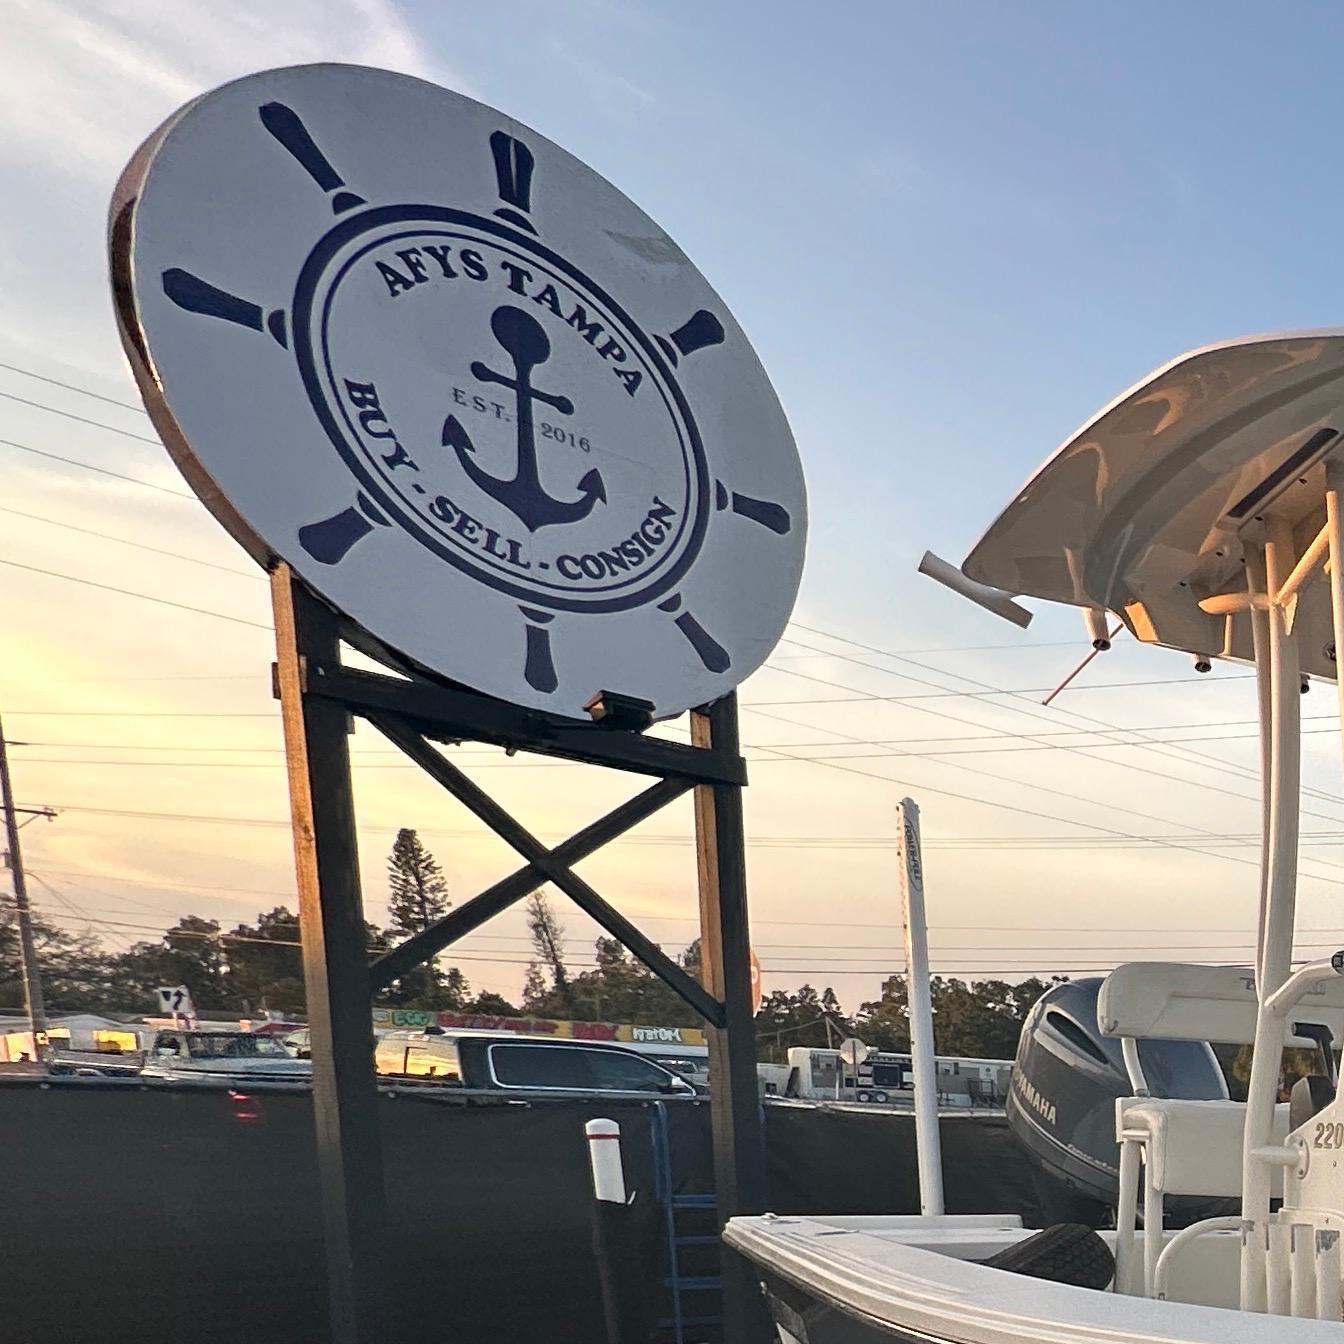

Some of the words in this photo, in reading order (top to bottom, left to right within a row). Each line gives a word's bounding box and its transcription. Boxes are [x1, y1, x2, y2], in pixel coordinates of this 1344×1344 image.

[375, 245, 489, 298] AFYS
[500, 261, 643, 398] TAMPA
[344, 378, 420, 472] BUY
[429, 495, 532, 570] SELL
[556, 496, 678, 581] CONSIGN
[452, 386, 511, 423] EST.
[539, 422, 591, 453] 2016
